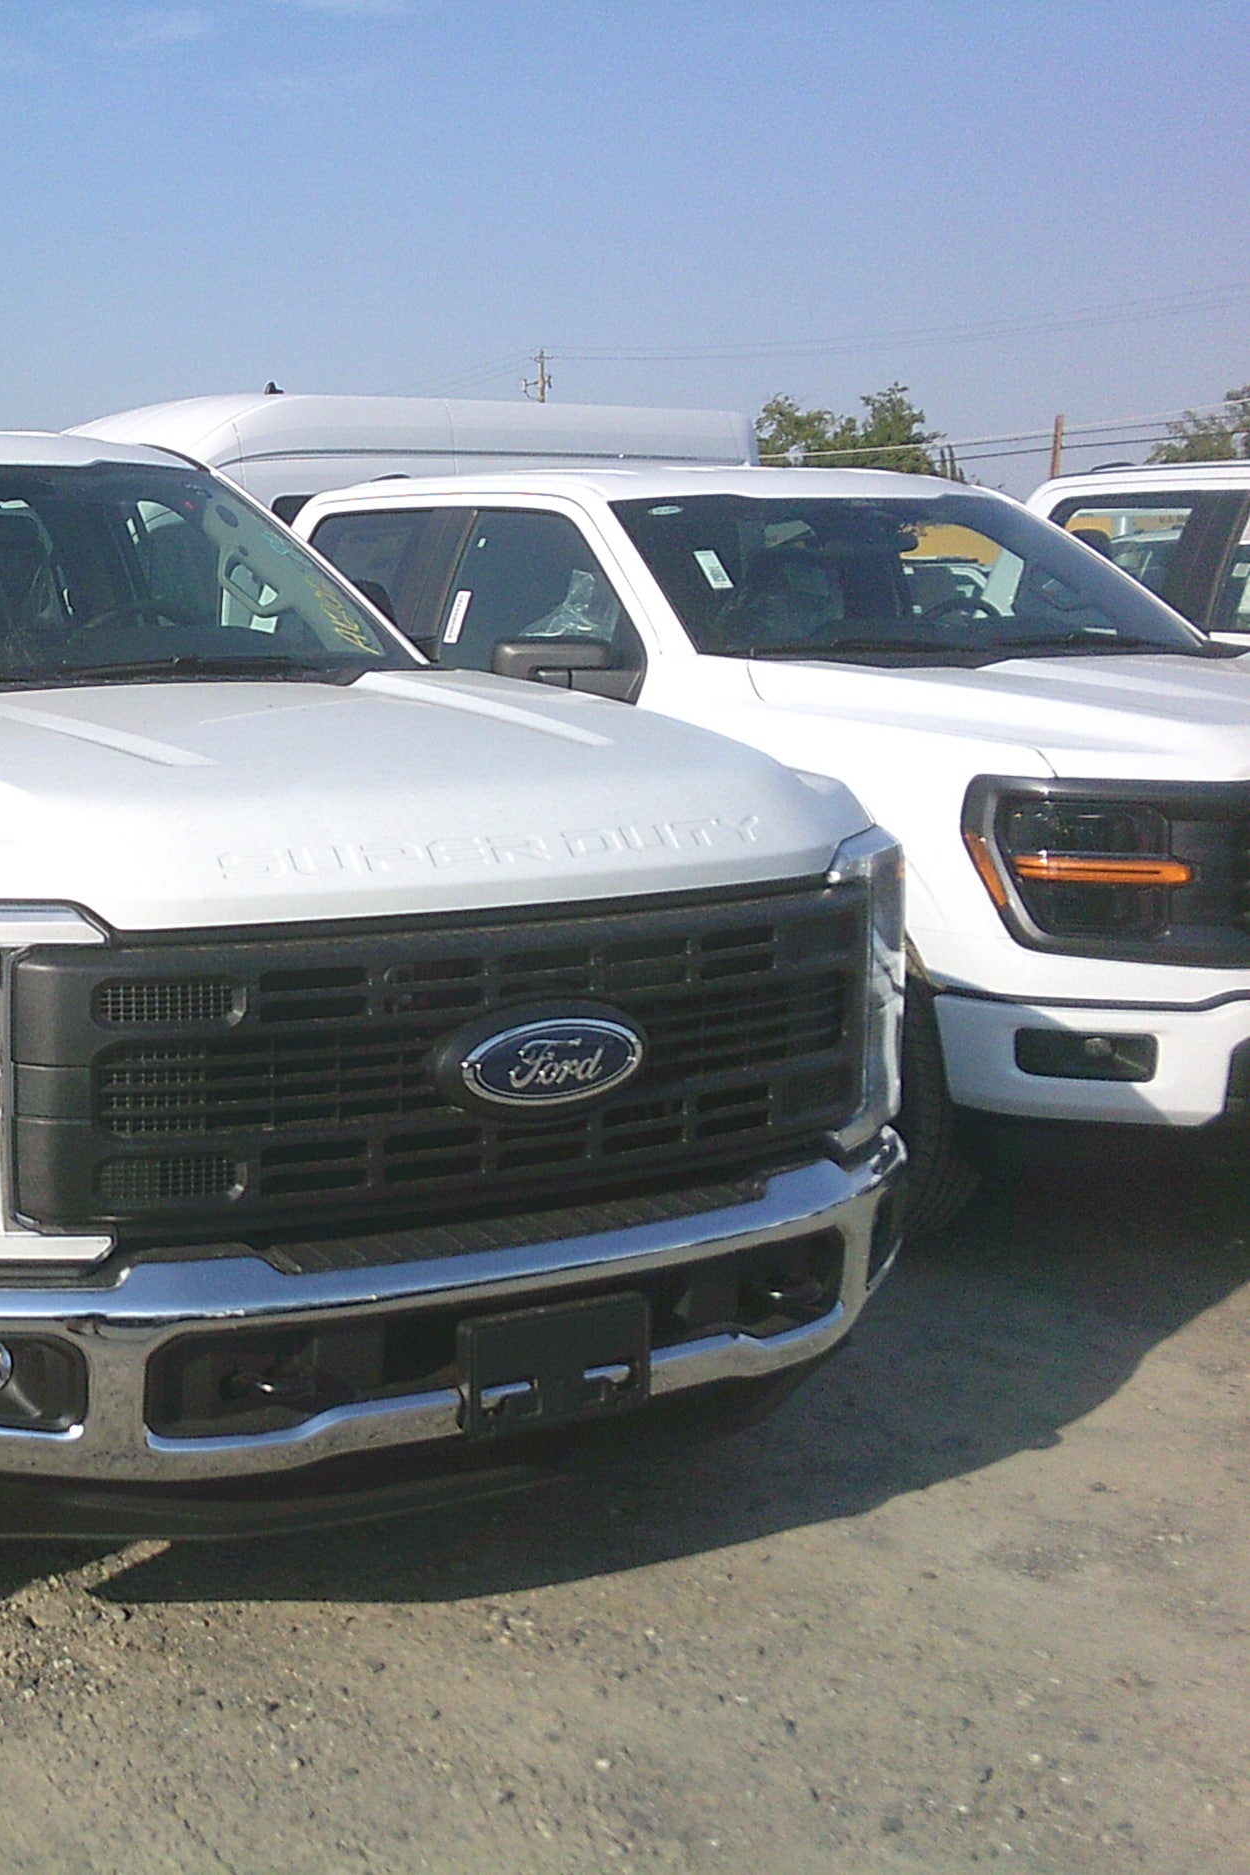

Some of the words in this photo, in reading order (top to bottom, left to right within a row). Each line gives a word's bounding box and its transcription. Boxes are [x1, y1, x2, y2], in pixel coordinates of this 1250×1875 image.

[217, 834, 551, 880] SUPER
[561, 816, 758, 858] DUTY
[508, 1038, 603, 1089] Ford
